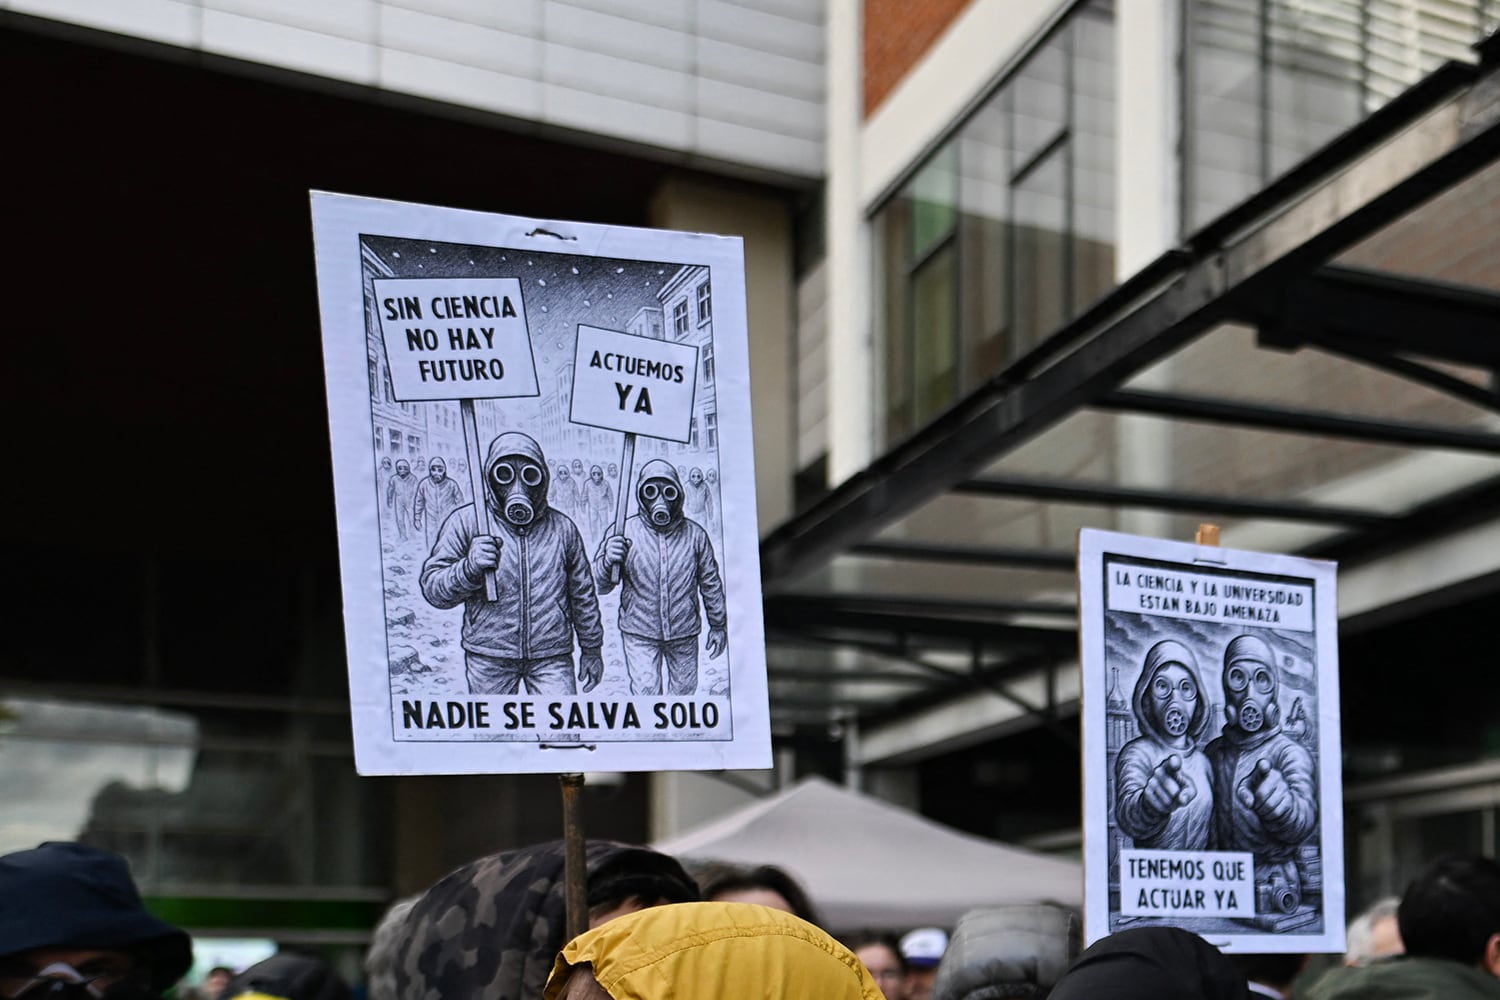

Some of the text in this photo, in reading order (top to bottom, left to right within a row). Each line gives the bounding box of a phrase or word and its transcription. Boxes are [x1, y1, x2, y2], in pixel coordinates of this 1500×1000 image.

[384, 296, 516, 321] SIN CIENCIA
[406, 328, 494, 351] NO HAY
[419, 359, 504, 382] FUTURO
[590, 350, 683, 383] ACTUEMOS
[615, 382, 652, 415] YA
[1117, 571, 1304, 606] LA CIENCIA Y LA UNIVERSIDAD
[1140, 594, 1281, 622] ESTAN BAJO AMENAZA
[402, 700, 718, 730] NADIE SE SALVA SOLO
[1129, 858, 1245, 881] TENEMOS QUE
[1138, 888, 1238, 909] ACTUAR YA
